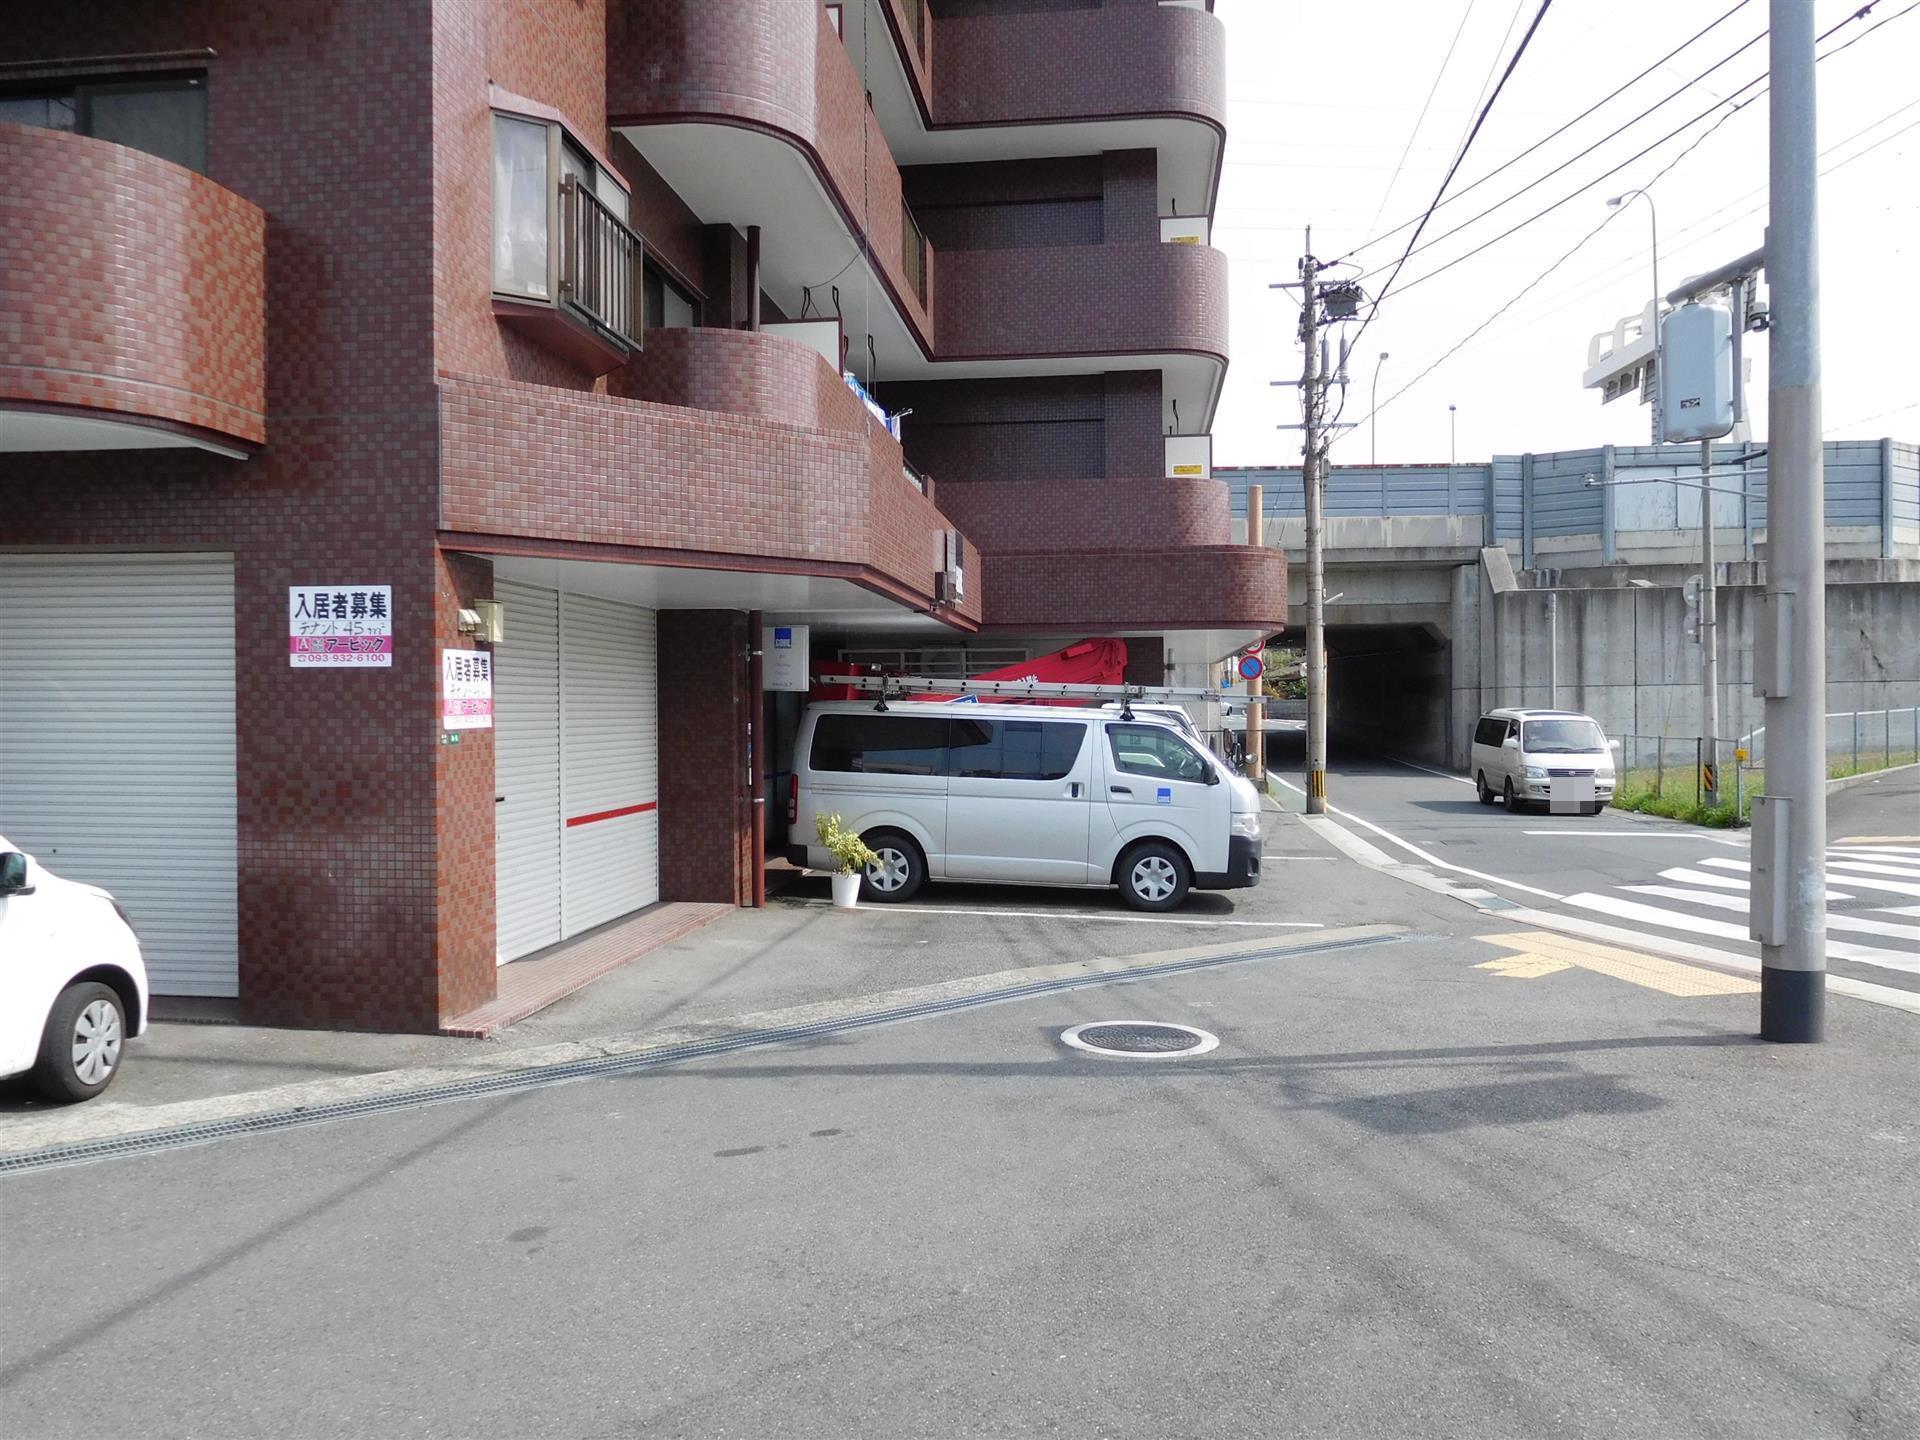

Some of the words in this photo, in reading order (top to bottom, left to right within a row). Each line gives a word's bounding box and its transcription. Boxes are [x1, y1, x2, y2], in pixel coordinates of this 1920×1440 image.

[295, 592, 386, 619] 入居者募集
[299, 621, 338, 635] テナント
[327, 638, 385, 651] アービック
[308, 654, 385, 662] 093-932-6100
[446, 656, 488, 681] 入居者募集
